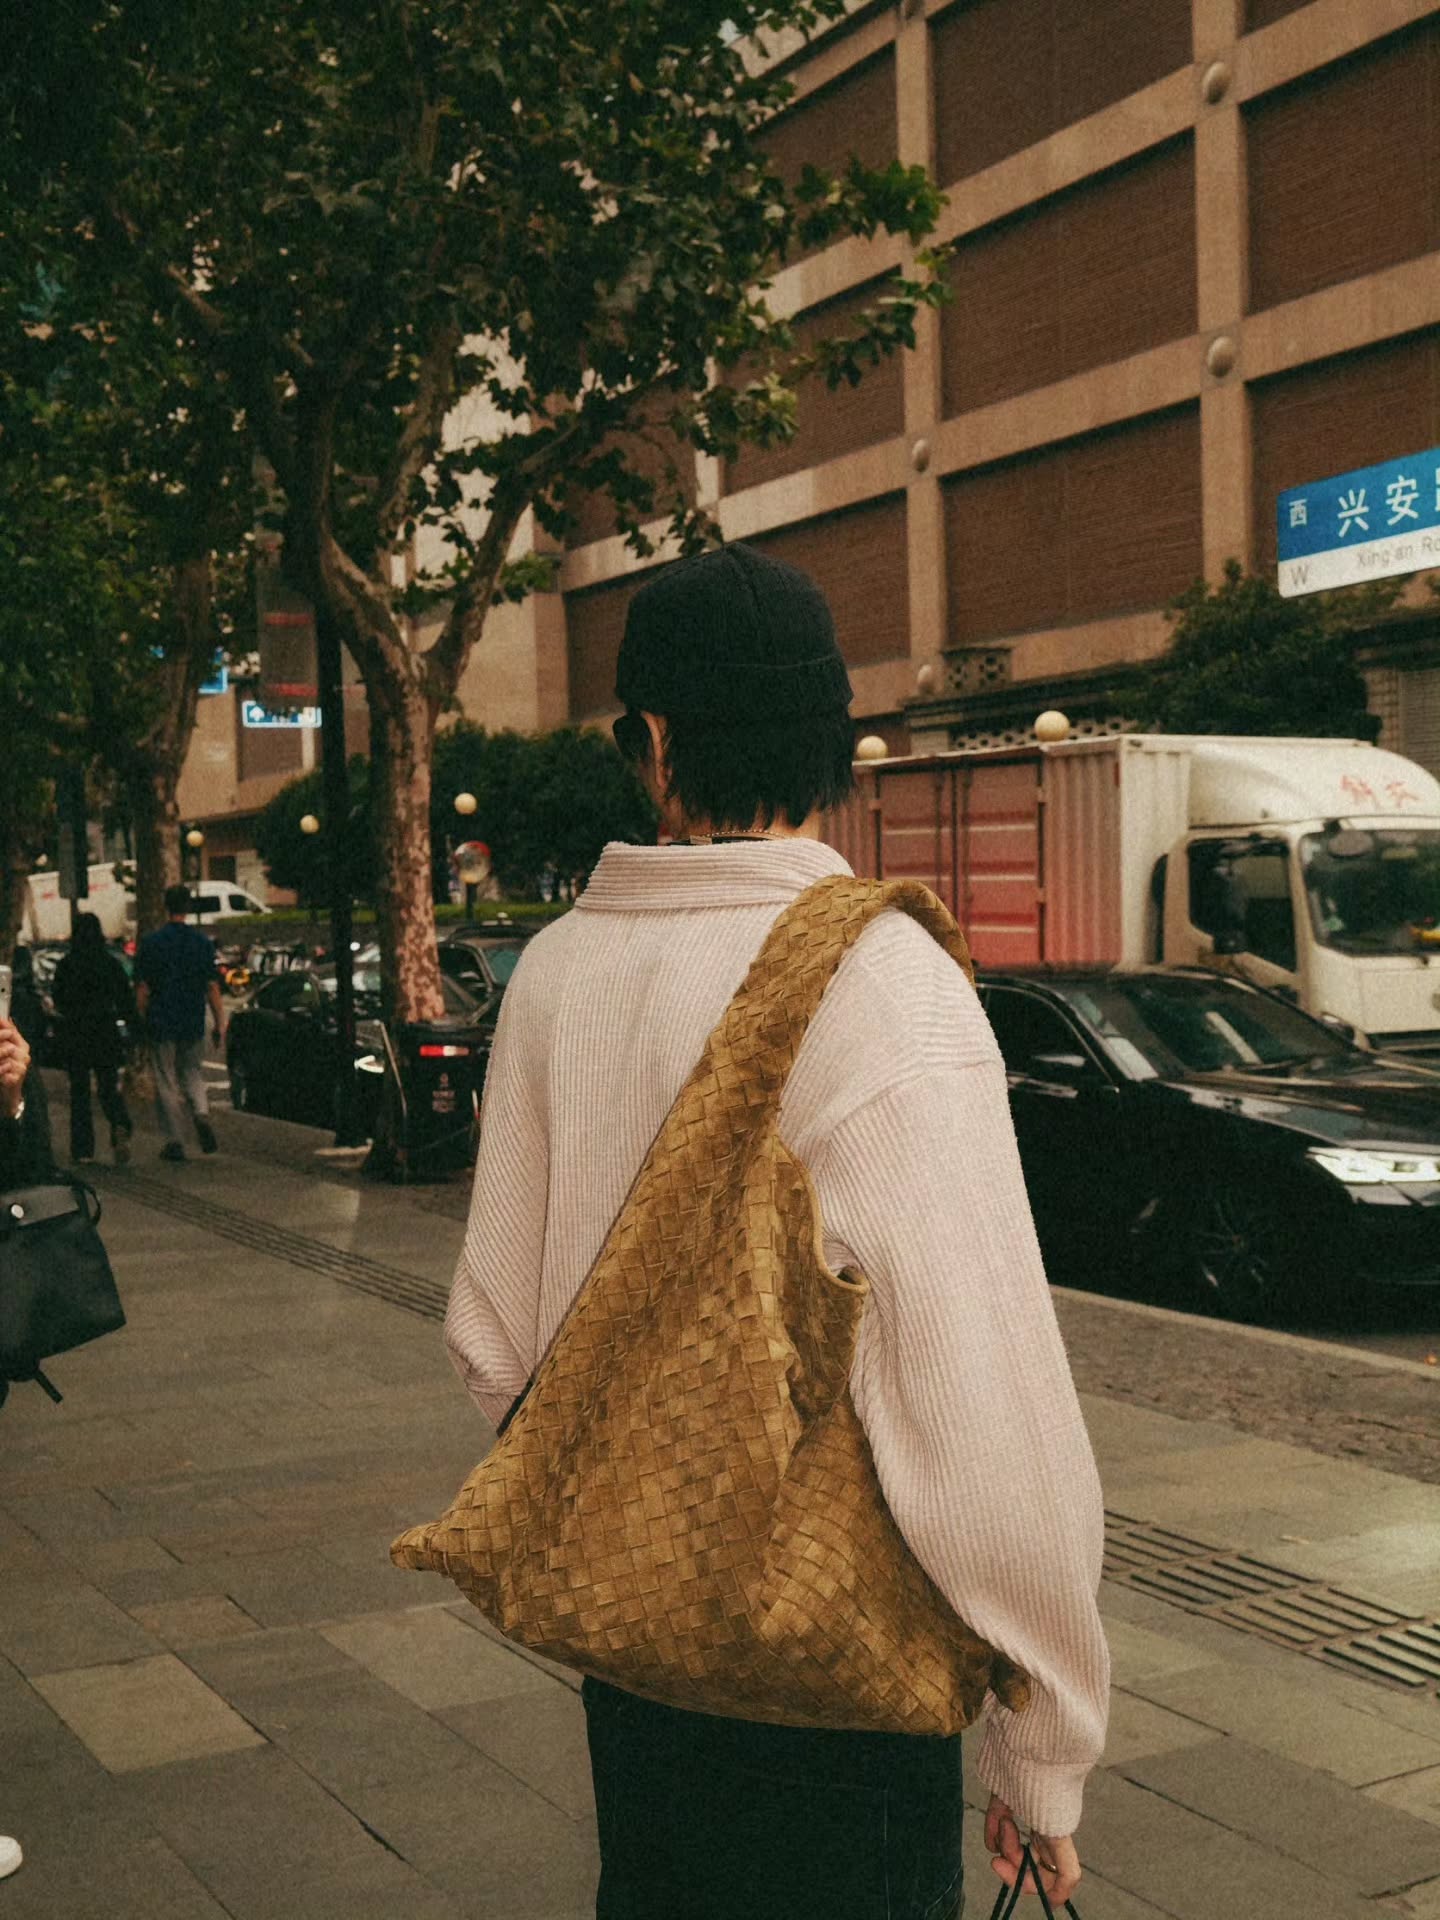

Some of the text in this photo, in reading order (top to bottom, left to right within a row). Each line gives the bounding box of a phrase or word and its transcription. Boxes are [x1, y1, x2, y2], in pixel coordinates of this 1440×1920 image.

[1289, 466, 1440, 538] 西 兴安
[1290, 563, 1310, 587] W
